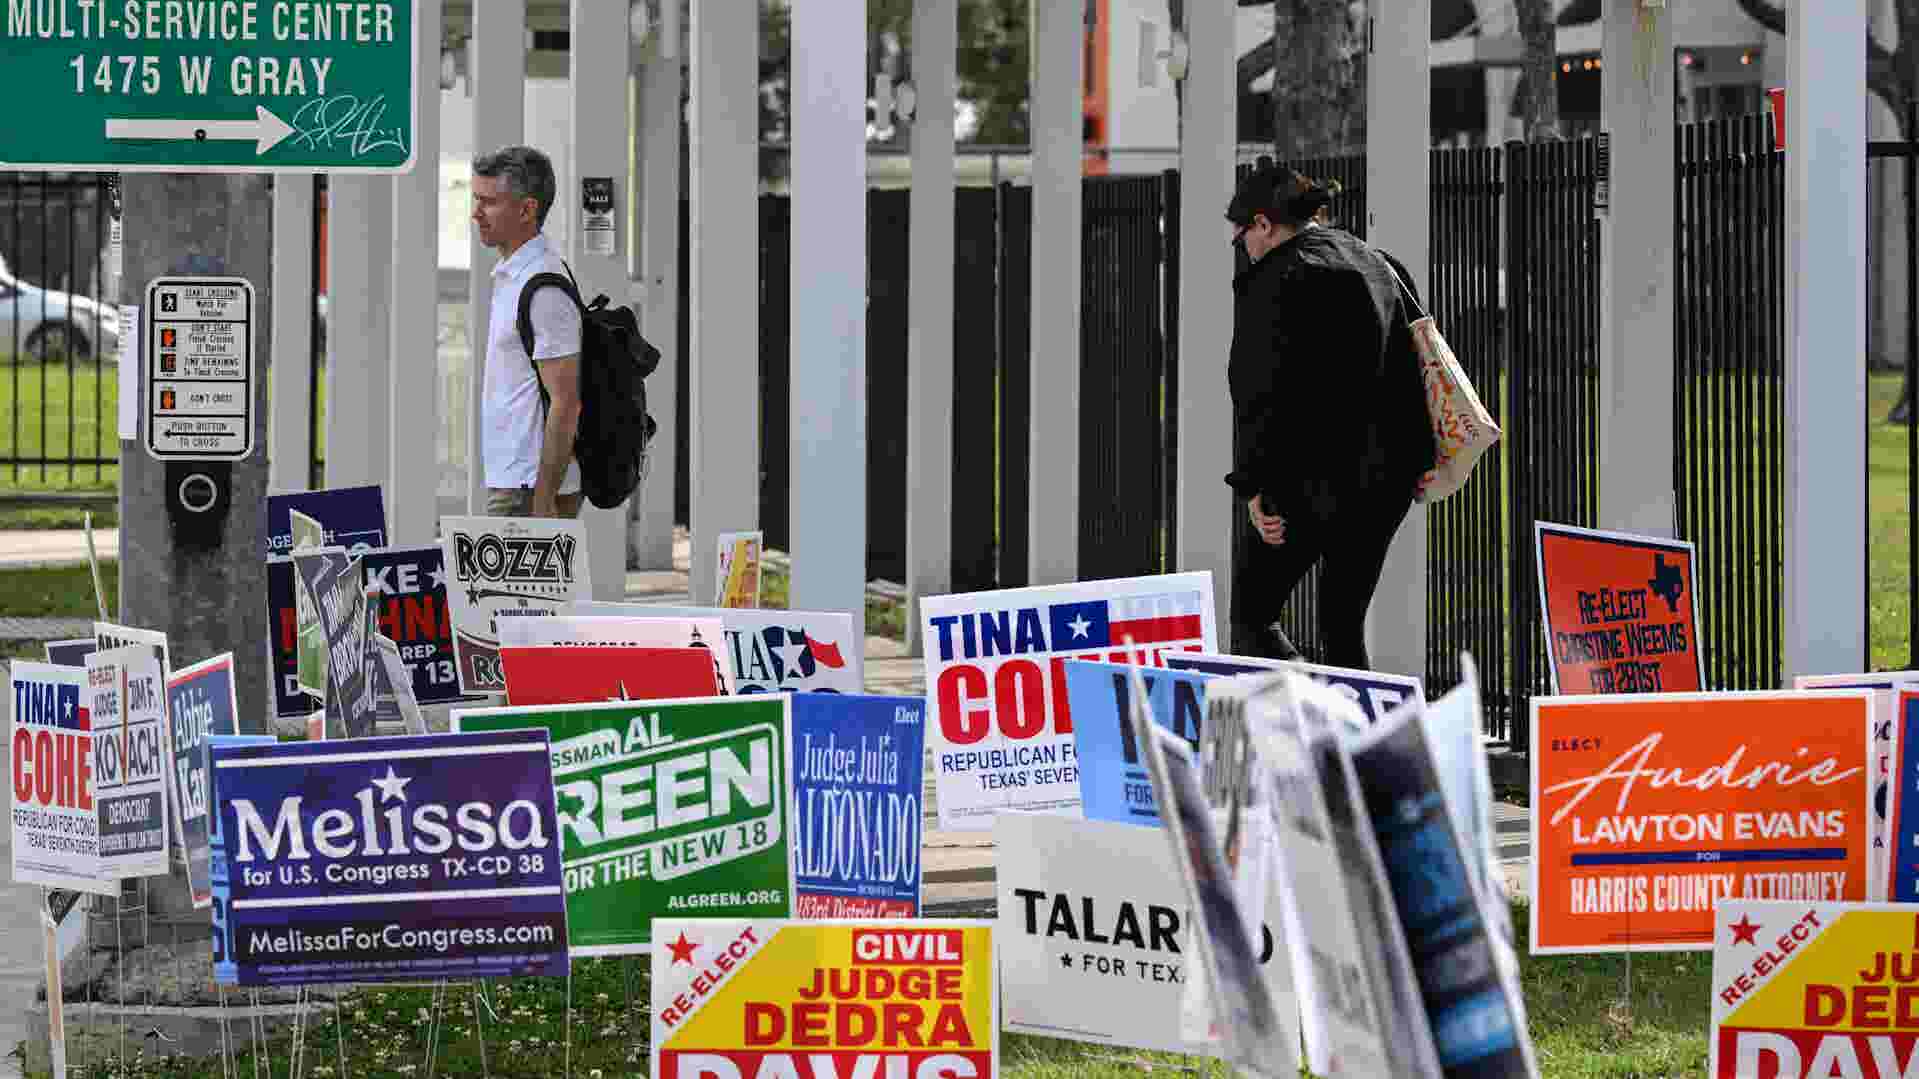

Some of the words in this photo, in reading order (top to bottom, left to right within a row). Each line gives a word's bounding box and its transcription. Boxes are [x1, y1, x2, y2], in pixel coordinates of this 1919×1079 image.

[7, 0, 259, 39] MULTI-SERVICE
[272, 2, 394, 42] CENTER
[69, 55, 162, 95] 1475
[179, 55, 213, 94] W
[230, 55, 333, 96] GRAY
[367, 564, 420, 595] KE
[453, 532, 578, 584] ROZZY
[401, 644, 437, 661] REP
[928, 607, 1048, 661] TINA
[424, 660, 456, 685] 13
[13, 680, 57, 726] TINA
[894, 705, 921, 724] Elect
[94, 726, 160, 784] KOVACH
[550, 740, 616, 768] SSMAN
[624, 711, 674, 752] AL
[942, 744, 1056, 773] REPUBLICAN
[1551, 738, 1602, 751] ELECT
[12, 728, 93, 811] COHE
[799, 732, 857, 794] Judge
[856, 732, 899, 785] Julia
[978, 770, 1031, 790] TEXAS'
[1542, 731, 1864, 827] Audrie
[176, 755, 208, 823] Ka
[556, 737, 772, 848] REEN
[230, 786, 549, 863] Melissa
[793, 787, 918, 886] ALDONADO
[1572, 813, 1723, 845] LAWTON
[1734, 809, 1847, 839] EVANS
[243, 866, 272, 887] for
[279, 864, 320, 886] U.S.
[325, 861, 430, 885] Congress
[441, 856, 512, 878] TX-CD
[563, 864, 596, 894] OR
[599, 854, 650, 884] THE
[661, 829, 727, 871] NEW
[735, 822, 769, 851] 18
[668, 889, 783, 910] ALGREEN.ORG
[1570, 875, 1648, 914] HARRIS
[1653, 873, 1736, 912] COUNTY
[1740, 871, 1847, 902] ATTORNEY
[249, 923, 554, 955] MelissaForCongress.com
[854, 932, 961, 961] CIVIL
[1719, 909, 1823, 1007] RE-ELECT
[659, 926, 760, 1028] RE-ELECT
[798, 967, 963, 1000] JUDGE
[1082, 953, 1127, 977] FOR
[1136, 961, 1186, 985] TEX
[1857, 951, 1919, 983] JU
[744, 1001, 975, 1047] DEDRA
[1803, 983, 1919, 1028] DED
[676, 1052, 979, 1079] DAVIS
[1736, 1031, 1919, 1079] DAV
